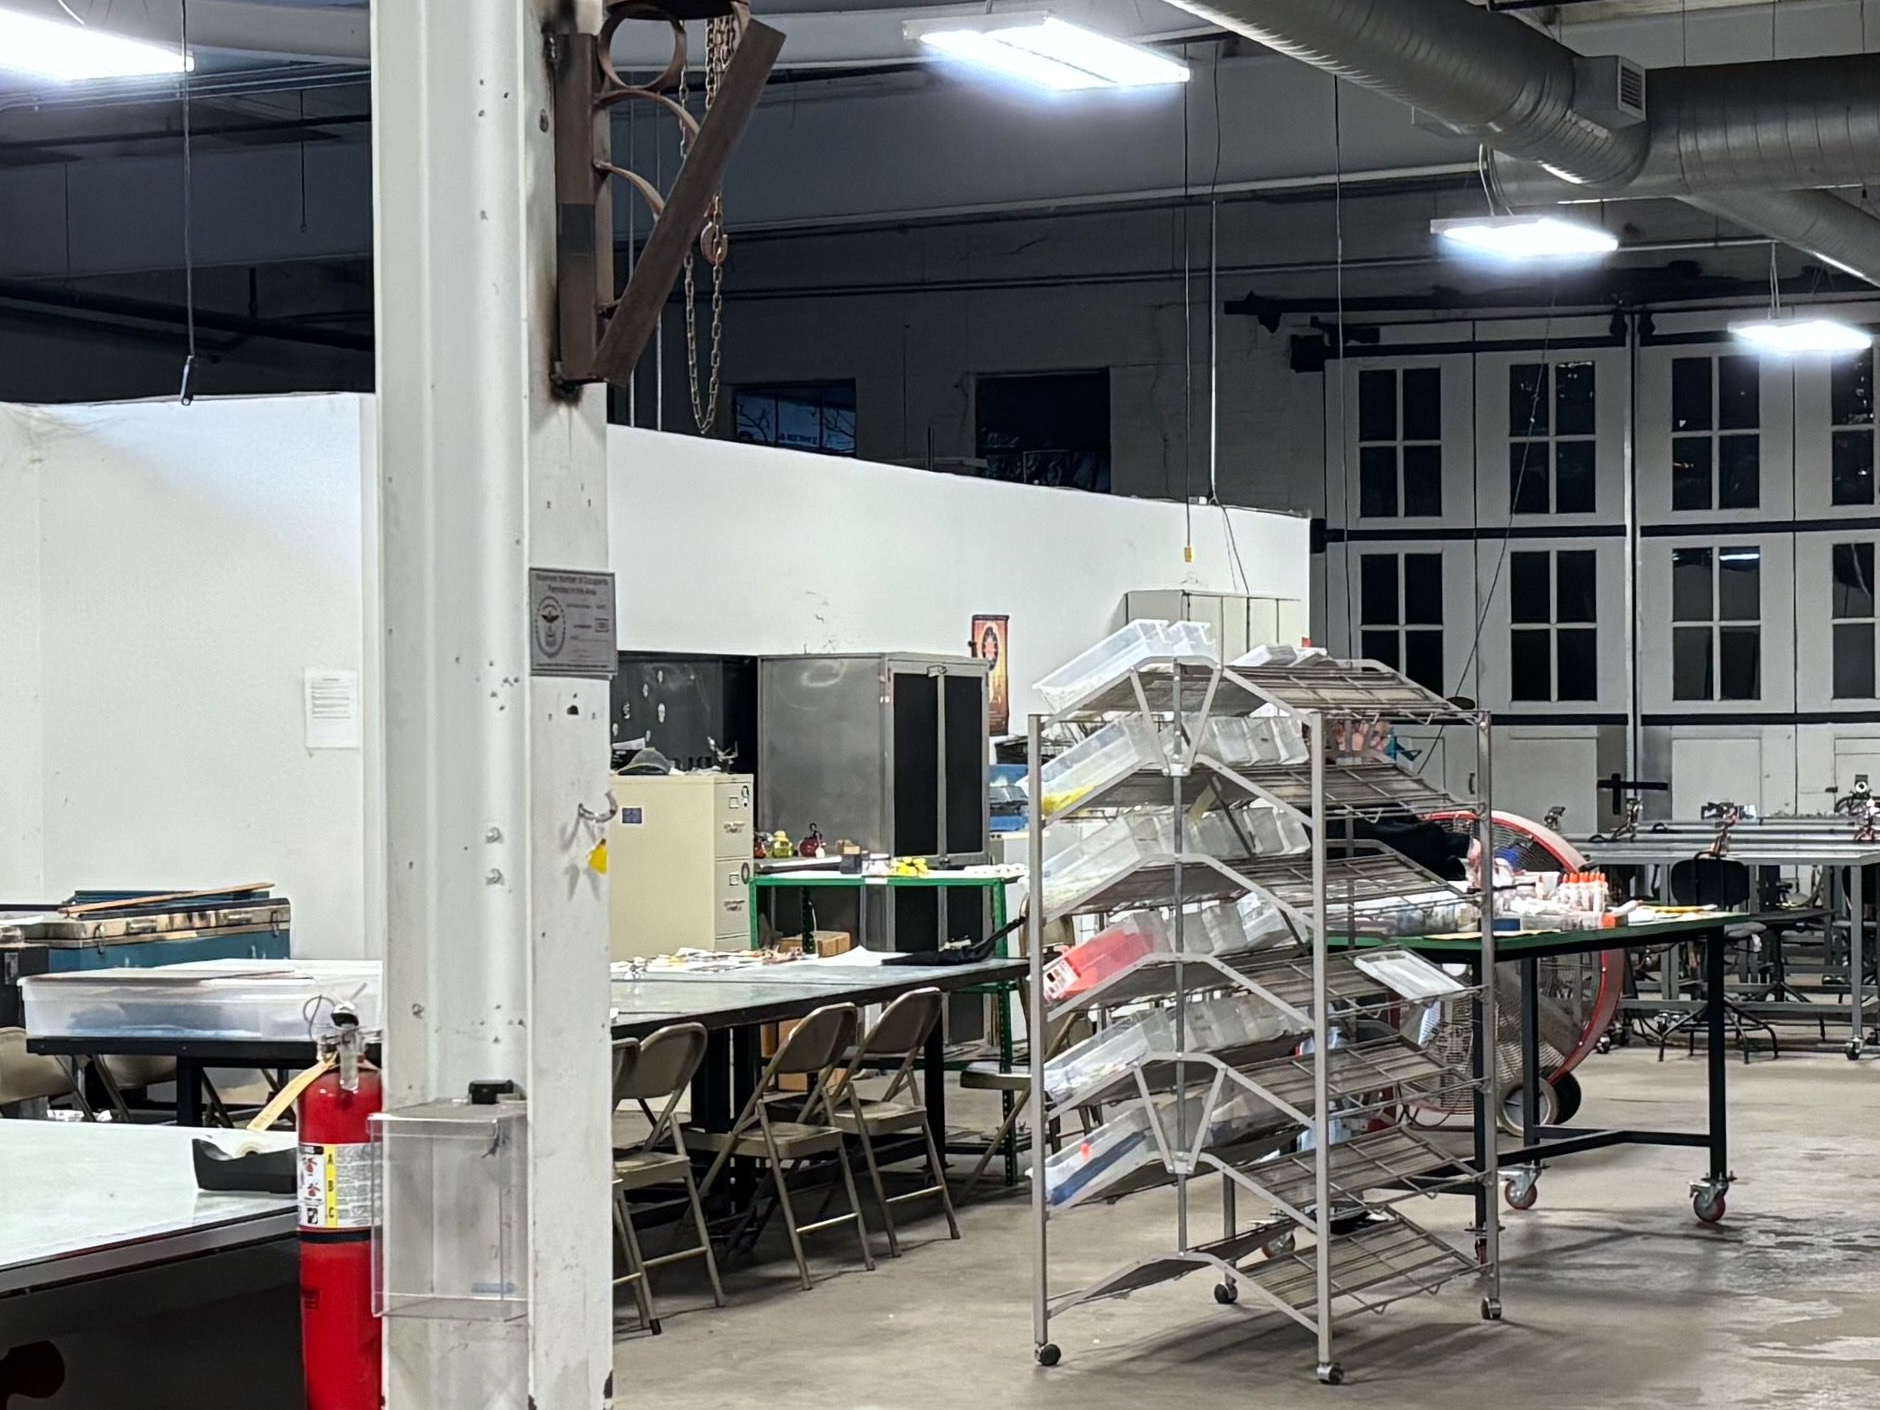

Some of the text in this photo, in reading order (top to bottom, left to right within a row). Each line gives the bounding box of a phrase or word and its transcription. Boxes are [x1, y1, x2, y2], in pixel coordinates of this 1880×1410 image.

[327, 1153, 334, 1166] A
[327, 1179, 334, 1192] B
[328, 1206, 335, 1219] C
